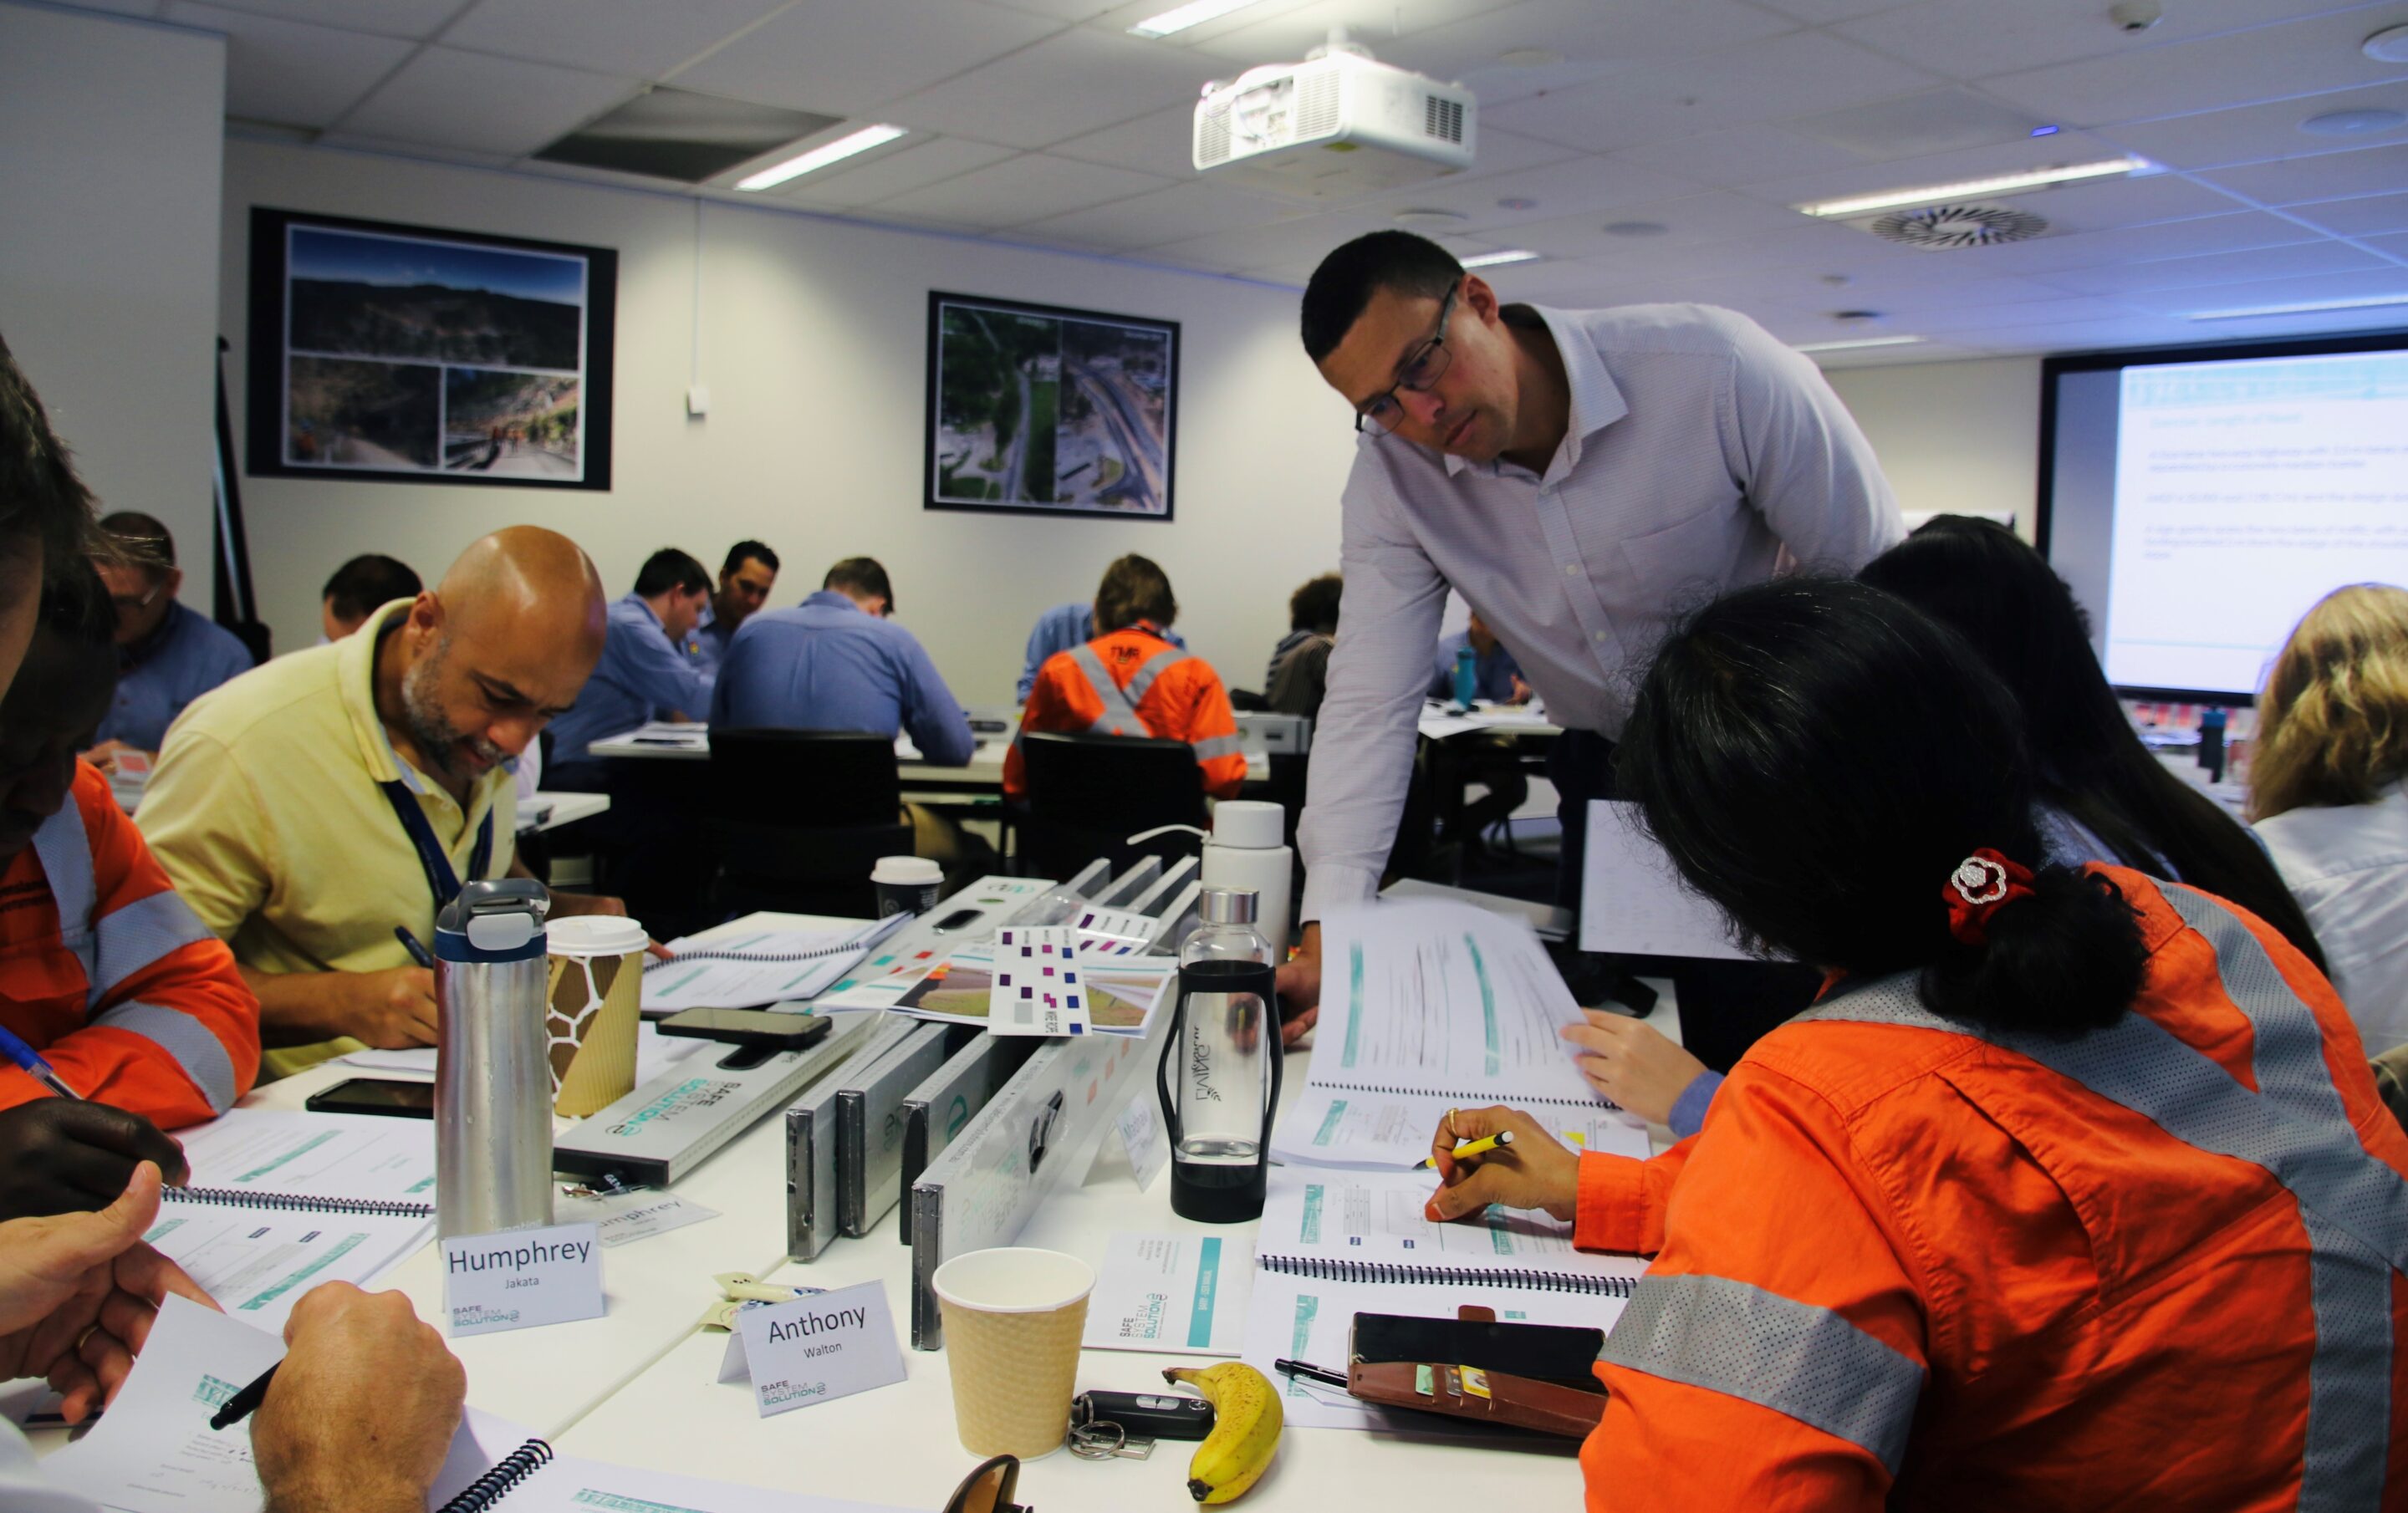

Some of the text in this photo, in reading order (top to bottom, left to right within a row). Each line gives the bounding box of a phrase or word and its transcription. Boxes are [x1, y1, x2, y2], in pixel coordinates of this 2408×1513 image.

[696, 1081, 742, 1108] SAFE
[449, 1240, 591, 1275] Humphrey
[505, 1276, 540, 1290] Jakata
[452, 1305, 482, 1315] SAFE
[453, 1309, 502, 1322] SYSTEM
[768, 1306, 866, 1344] Anthony
[1120, 1317, 1135, 1338] SAFE
[1131, 1306, 1149, 1338] SYSTEM
[804, 1342, 843, 1359] Walton
[761, 1380, 790, 1393] SAFE
[763, 1383, 809, 1400] SYSTEM
